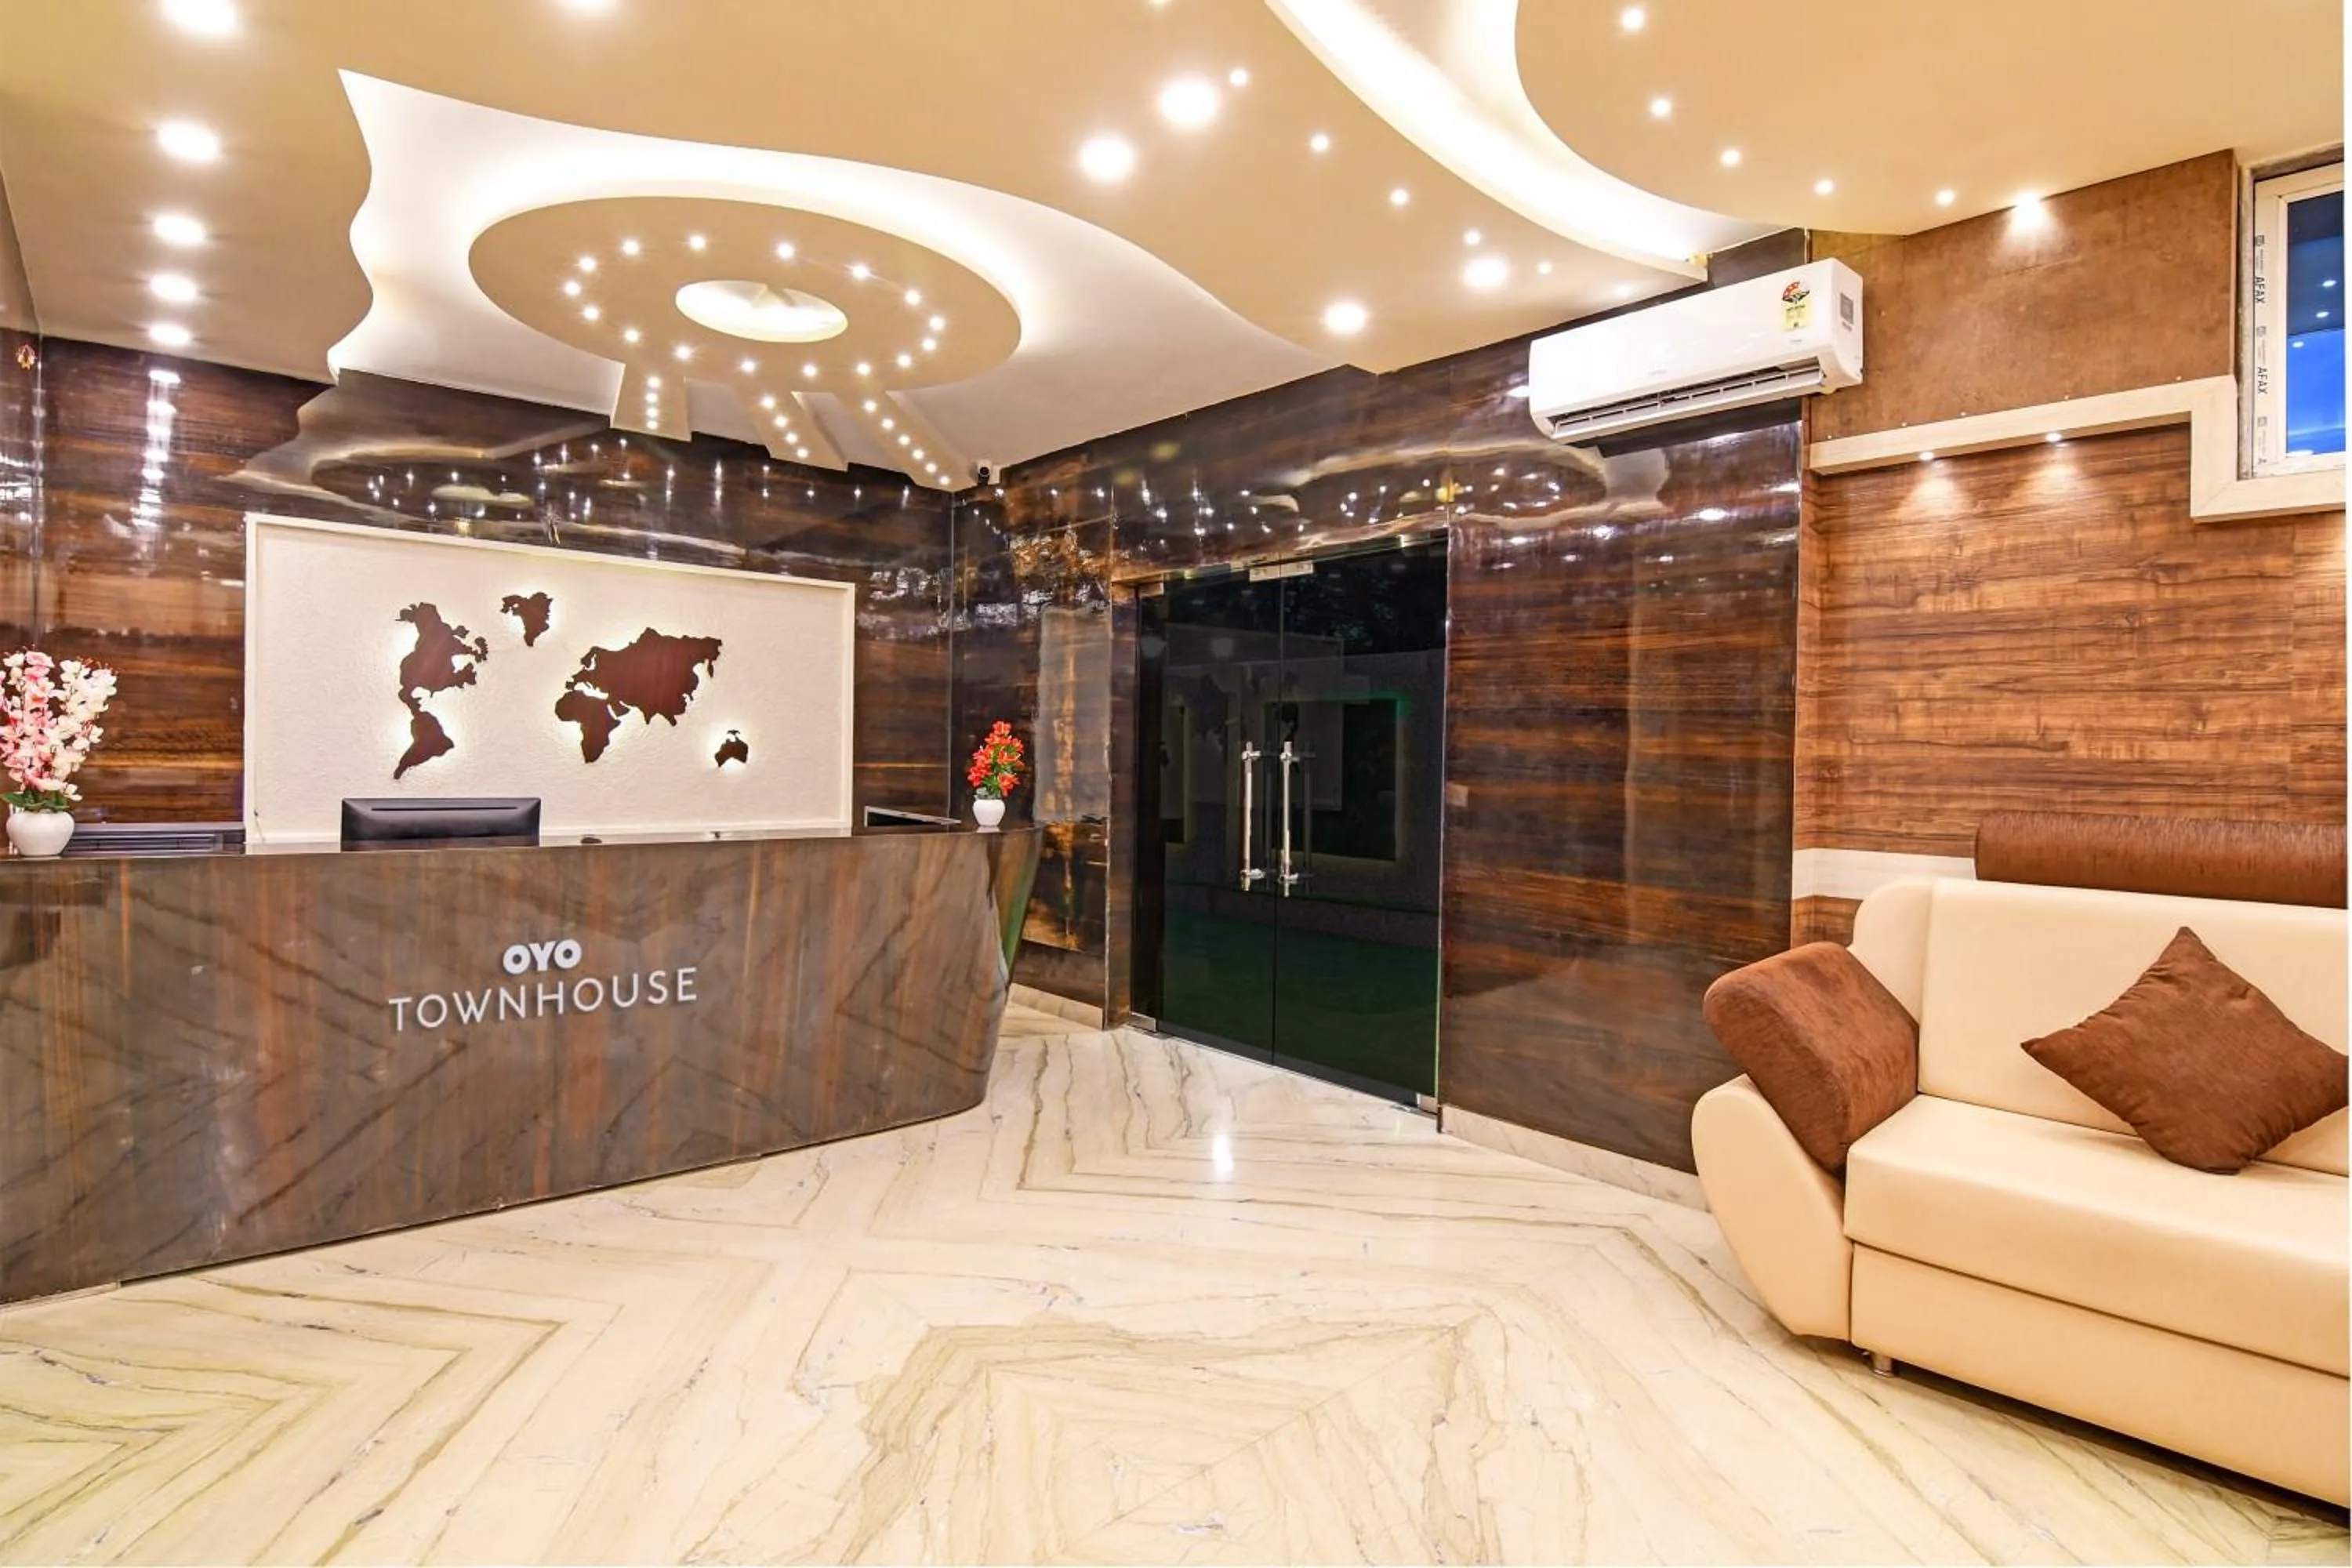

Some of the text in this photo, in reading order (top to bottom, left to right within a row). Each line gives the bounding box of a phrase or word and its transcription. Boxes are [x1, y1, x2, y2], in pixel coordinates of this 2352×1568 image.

[2257, 366, 2268, 394] AFAX
[503, 938, 583, 975] OYO
[388, 967, 698, 1032] TOWNHOUSE
